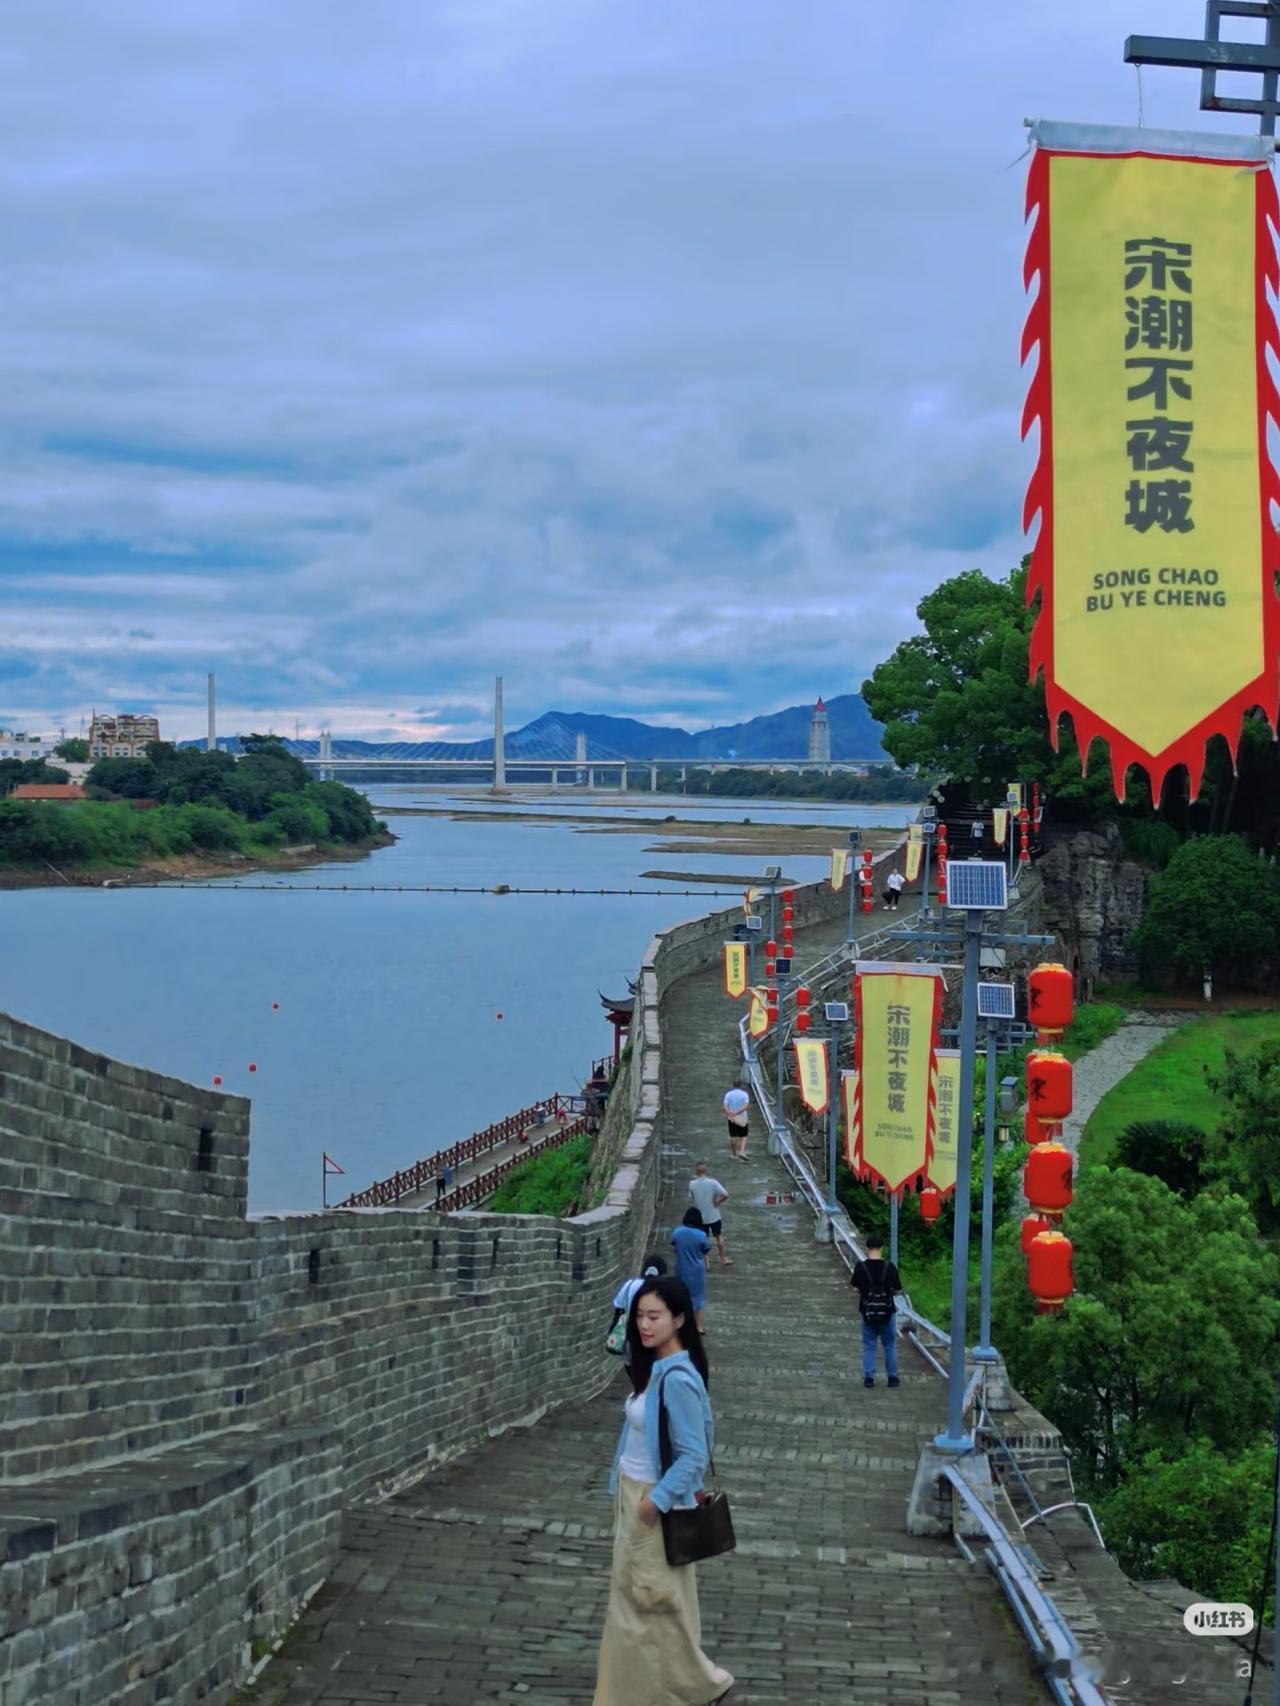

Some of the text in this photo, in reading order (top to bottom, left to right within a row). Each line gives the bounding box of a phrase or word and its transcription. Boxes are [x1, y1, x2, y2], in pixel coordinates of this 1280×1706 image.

[1125, 237, 1195, 533] 宋潮不夜城
[1093, 568, 1219, 590] SONG CHAO
[1086, 589, 1226, 612] BU YE CHENG
